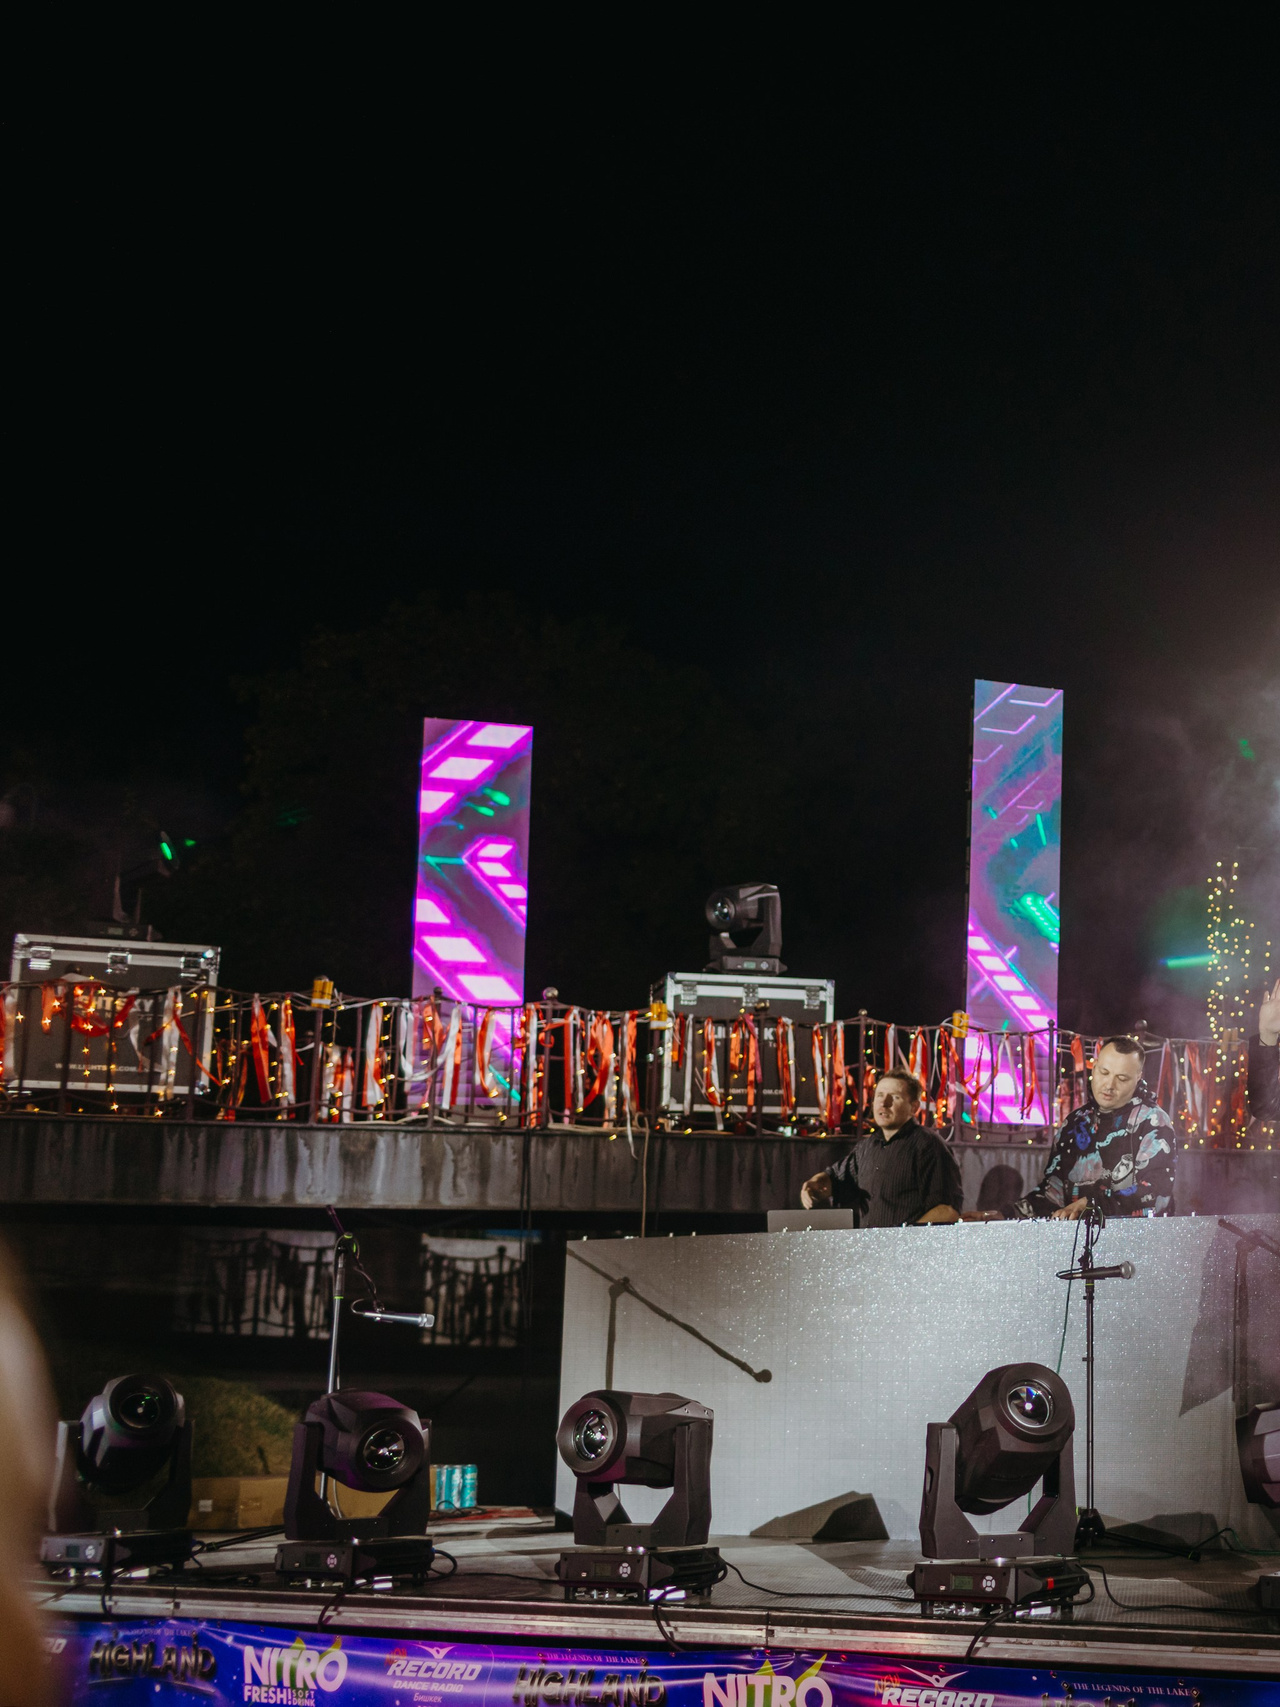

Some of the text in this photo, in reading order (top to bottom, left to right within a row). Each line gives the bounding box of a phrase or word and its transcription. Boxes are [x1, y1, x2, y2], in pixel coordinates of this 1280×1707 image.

[89, 1636, 218, 1682] HIGHLAND
[620, 1656, 639, 1664] LAKE
[244, 1645, 348, 1692] NITRO
[387, 1660, 482, 1681] RECORD
[393, 1680, 464, 1693] DANCE RADIO
[512, 1664, 666, 1706] HIGHLAND
[704, 1672, 832, 1707] NITRO
[1091, 1683, 1131, 1693] LEGENDS
[1132, 1685, 1144, 1694] OF
[1147, 1687, 1165, 1695] THE
[1166, 1688, 1192, 1697] LAKE
[244, 1684, 292, 1706] FRESH!
[292, 1689, 315, 1699] SOFT
[292, 1697, 315, 1707] DRINK
[413, 1692, 443, 1703] Бишкек
